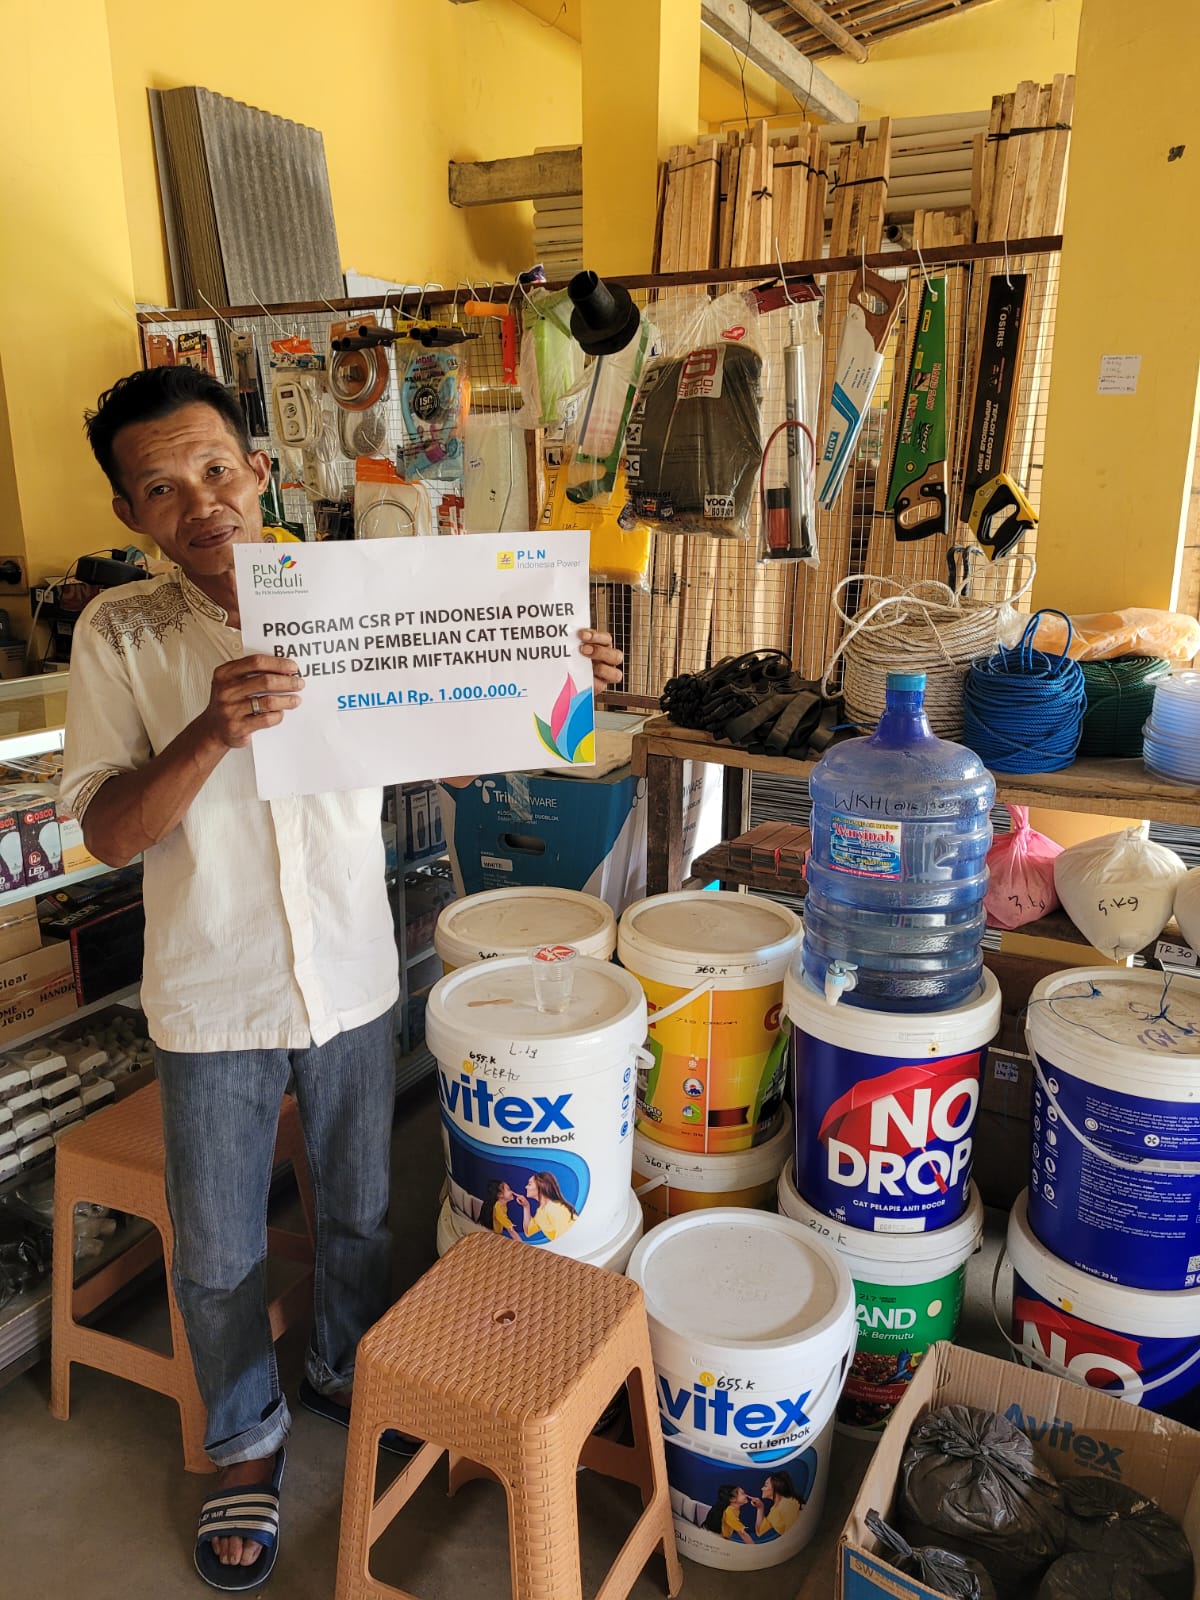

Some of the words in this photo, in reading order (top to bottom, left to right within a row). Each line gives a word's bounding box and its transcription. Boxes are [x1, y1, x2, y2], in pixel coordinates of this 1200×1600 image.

[824, 433, 838, 459] ADIT
[517, 550, 546, 560] PLN
[517, 560, 555, 569] Indonesia
[557, 559, 581, 568] Power
[252, 564, 277, 575] PLN
[253, 571, 303, 589] Peduli
[263, 616, 355, 638] PROGRAM
[359, 613, 391, 629] CSR
[395, 611, 415, 626] PT
[420, 605, 513, 625] INDONESIA
[517, 602, 575, 619] POWER
[274, 637, 360, 659] BANTUAN
[364, 630, 462, 650] PEMBELIAN
[466, 628, 496, 643] CAT
[500, 624, 568, 642] TEMBOK
[351, 655, 408, 673] DZIKIR
[413, 648, 513, 669] MIFTAKHUN
[517, 645, 572, 664] NURUL
[337, 690, 403, 710] SENILAI
[408, 690, 433, 706] Rp.
[439, 683, 528, 701] 1.000.000,-
[834, 790, 881, 812] WKH
[24, 808, 54, 825] COSCO
[28, 866, 46, 877] LED
[1158, 943, 1172, 954] TR
[1175, 946, 1192, 959] 30
[440, 1071, 575, 1133] vitex
[869, 1076, 980, 1149] NO
[502, 1134, 524, 1145] cat
[527, 1132, 575, 1145] tembok
[827, 1136, 974, 1197] DROP
[852, 1199, 869, 1209] CAT
[870, 1203, 901, 1213] PELAPIS
[903, 1204, 921, 1213] ANTI
[921, 1199, 946, 1211] BOCOR
[871, 1331, 915, 1341] Bermutu
[1022, 1320, 1145, 1407] NO
[657, 1374, 813, 1439] vitex
[740, 1441, 763, 1450] cat
[766, 1426, 811, 1448] tembok
[1003, 1402, 1124, 1473] Avitex
